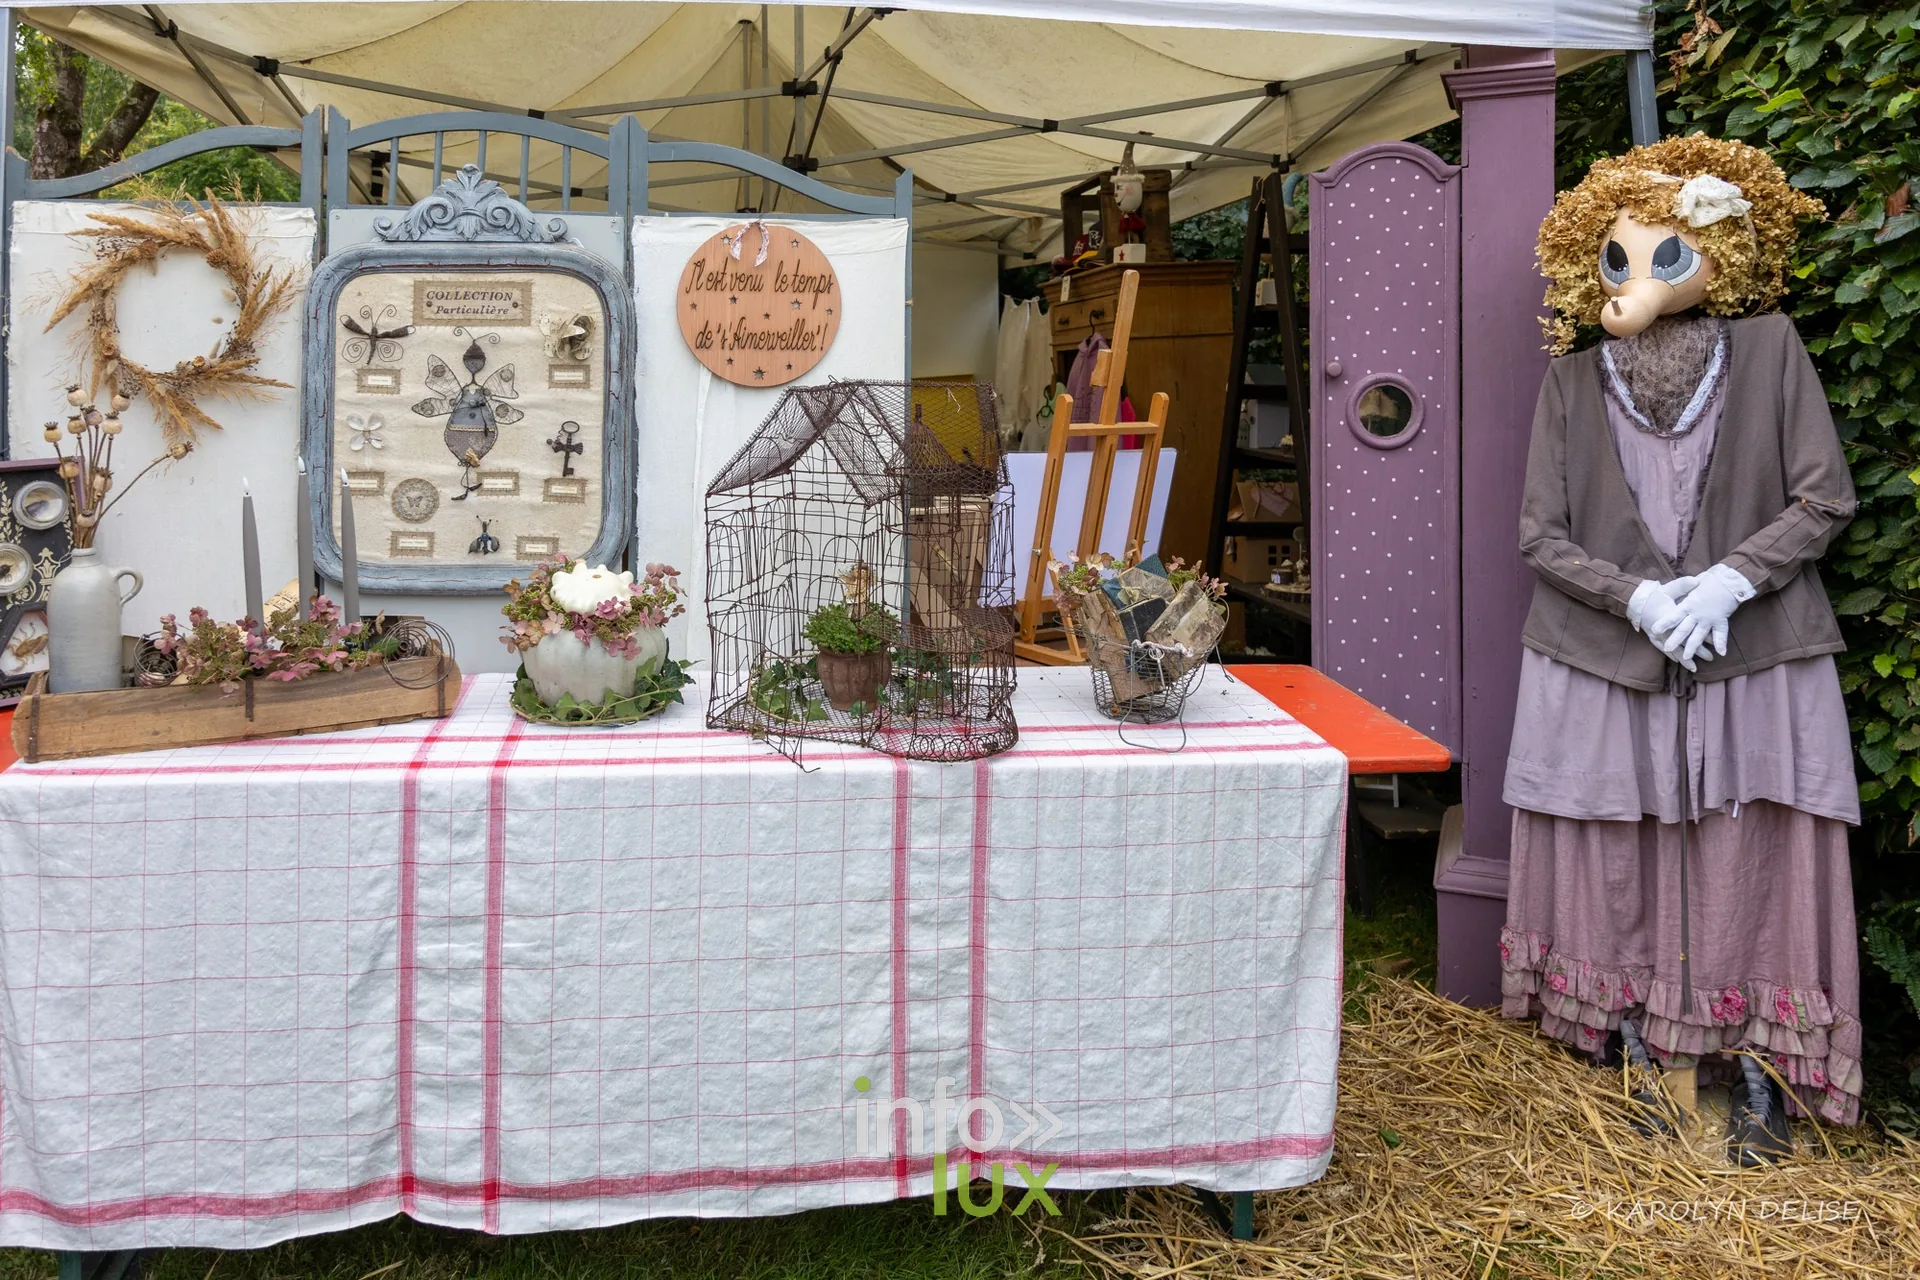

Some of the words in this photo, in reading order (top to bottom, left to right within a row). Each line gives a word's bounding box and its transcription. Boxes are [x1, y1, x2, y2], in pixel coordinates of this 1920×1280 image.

[706, 257, 728, 292] est
[729, 272, 764, 292] venu
[774, 260, 788, 293] le
[791, 259, 833, 310] temps
[426, 291, 513, 301] COLLECTION
[435, 305, 509, 315] Particulière
[695, 320, 713, 350] de
